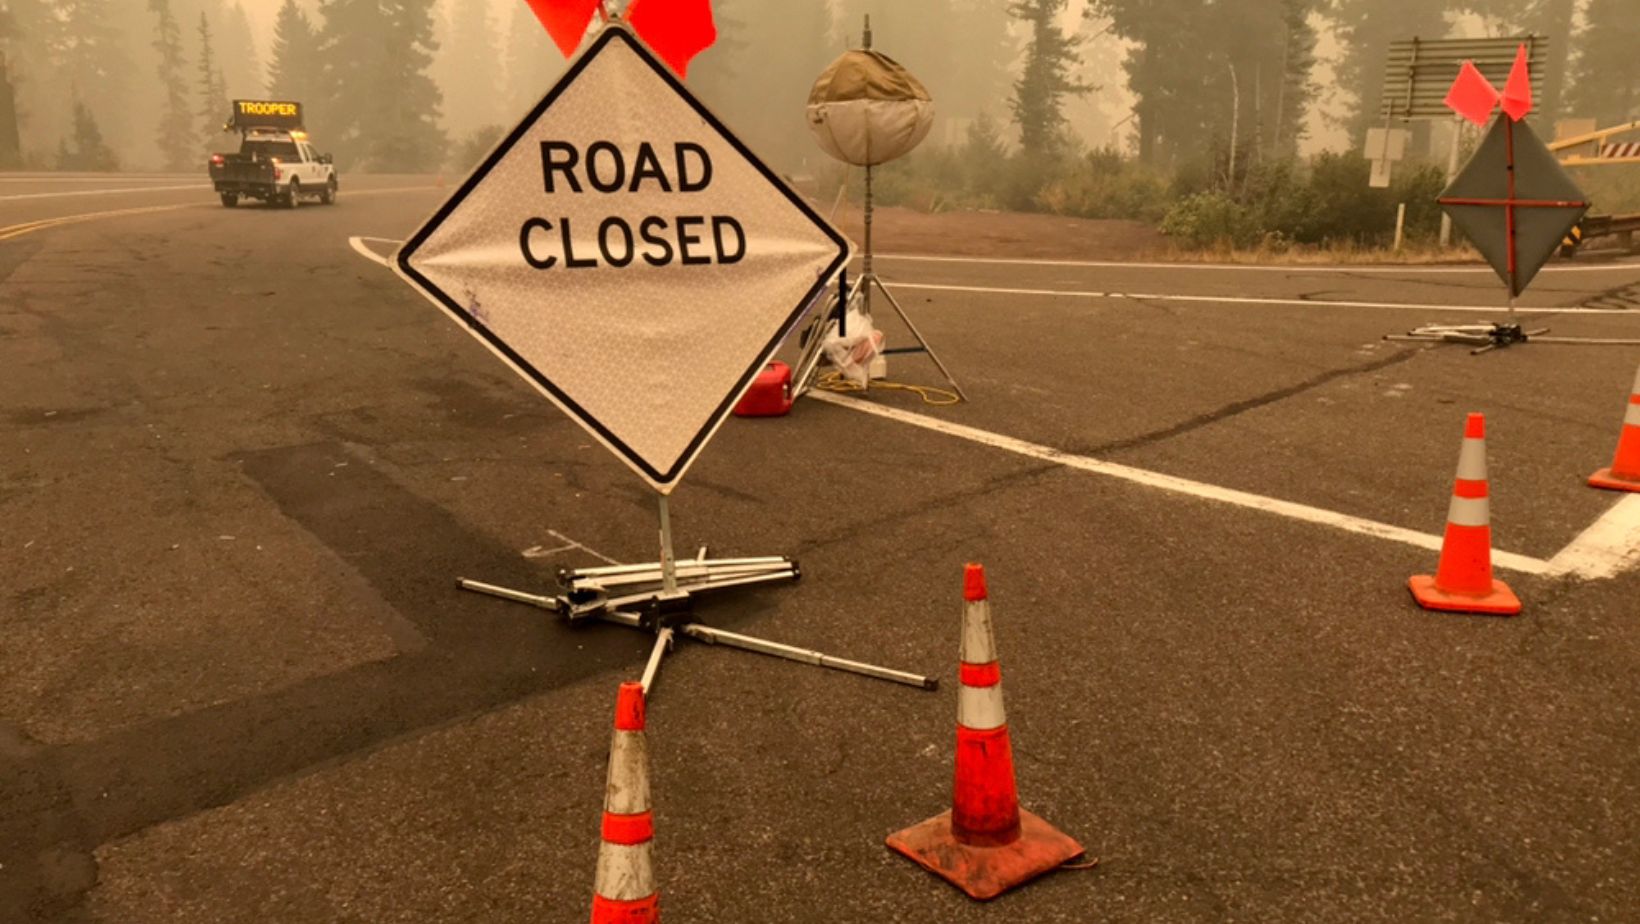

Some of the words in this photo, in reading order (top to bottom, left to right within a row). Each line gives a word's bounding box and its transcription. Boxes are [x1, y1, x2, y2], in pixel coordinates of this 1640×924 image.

[239, 101, 297, 116] TROOPER
[540, 140, 713, 194] ROAD
[519, 216, 746, 270] CLOSED
